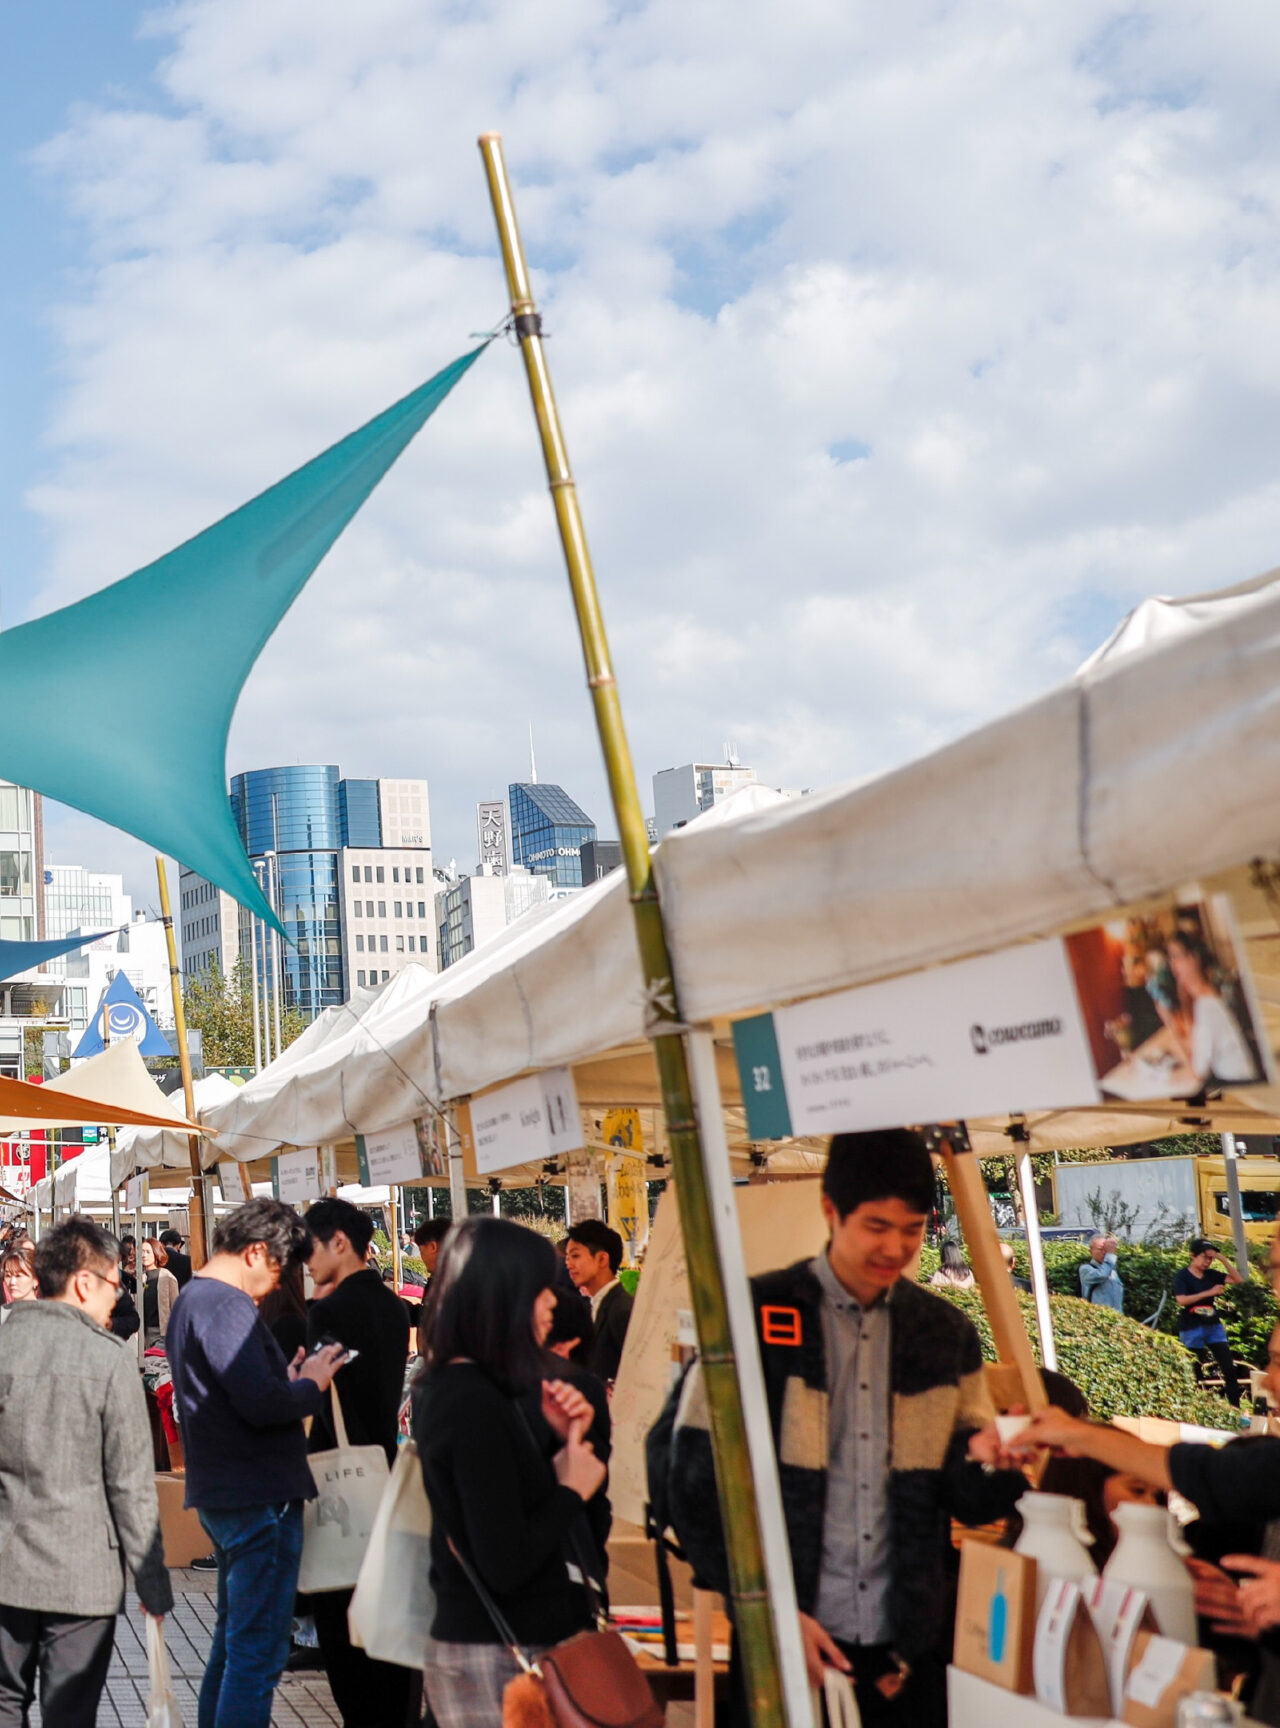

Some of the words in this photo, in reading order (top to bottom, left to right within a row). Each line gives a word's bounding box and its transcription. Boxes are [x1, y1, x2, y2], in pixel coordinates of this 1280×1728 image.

[528, 848, 555, 863] OHMOTO
[558, 847, 581, 857] OHM
[324, 1466, 366, 1483] LIFE
